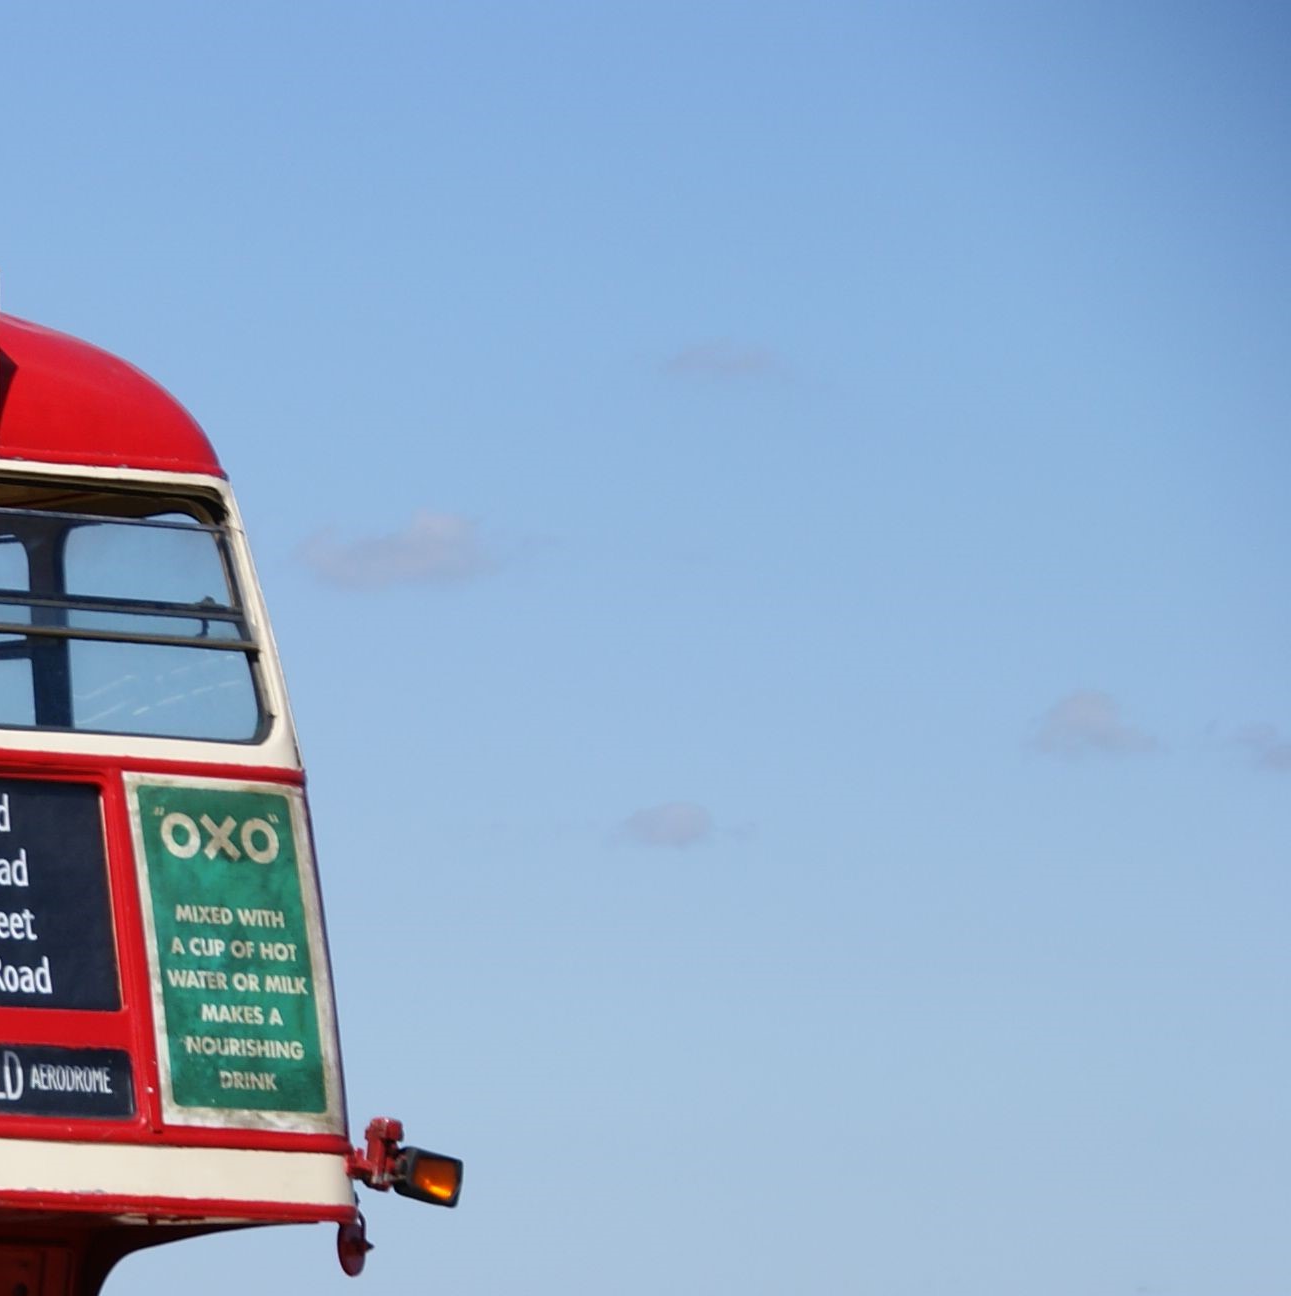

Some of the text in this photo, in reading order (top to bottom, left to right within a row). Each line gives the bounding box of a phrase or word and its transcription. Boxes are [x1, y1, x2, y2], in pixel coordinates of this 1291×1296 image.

[175, 903, 286, 928] MIXED WITH
[171, 936, 297, 962] A CUP OF HOT
[167, 969, 309, 995] WATER OR MILK
[201, 1003, 284, 1026] MAKES A
[185, 1035, 305, 1061] NOURISHING
[30, 1063, 113, 1095] AERODROME
[219, 1070, 279, 1092] DRINK
